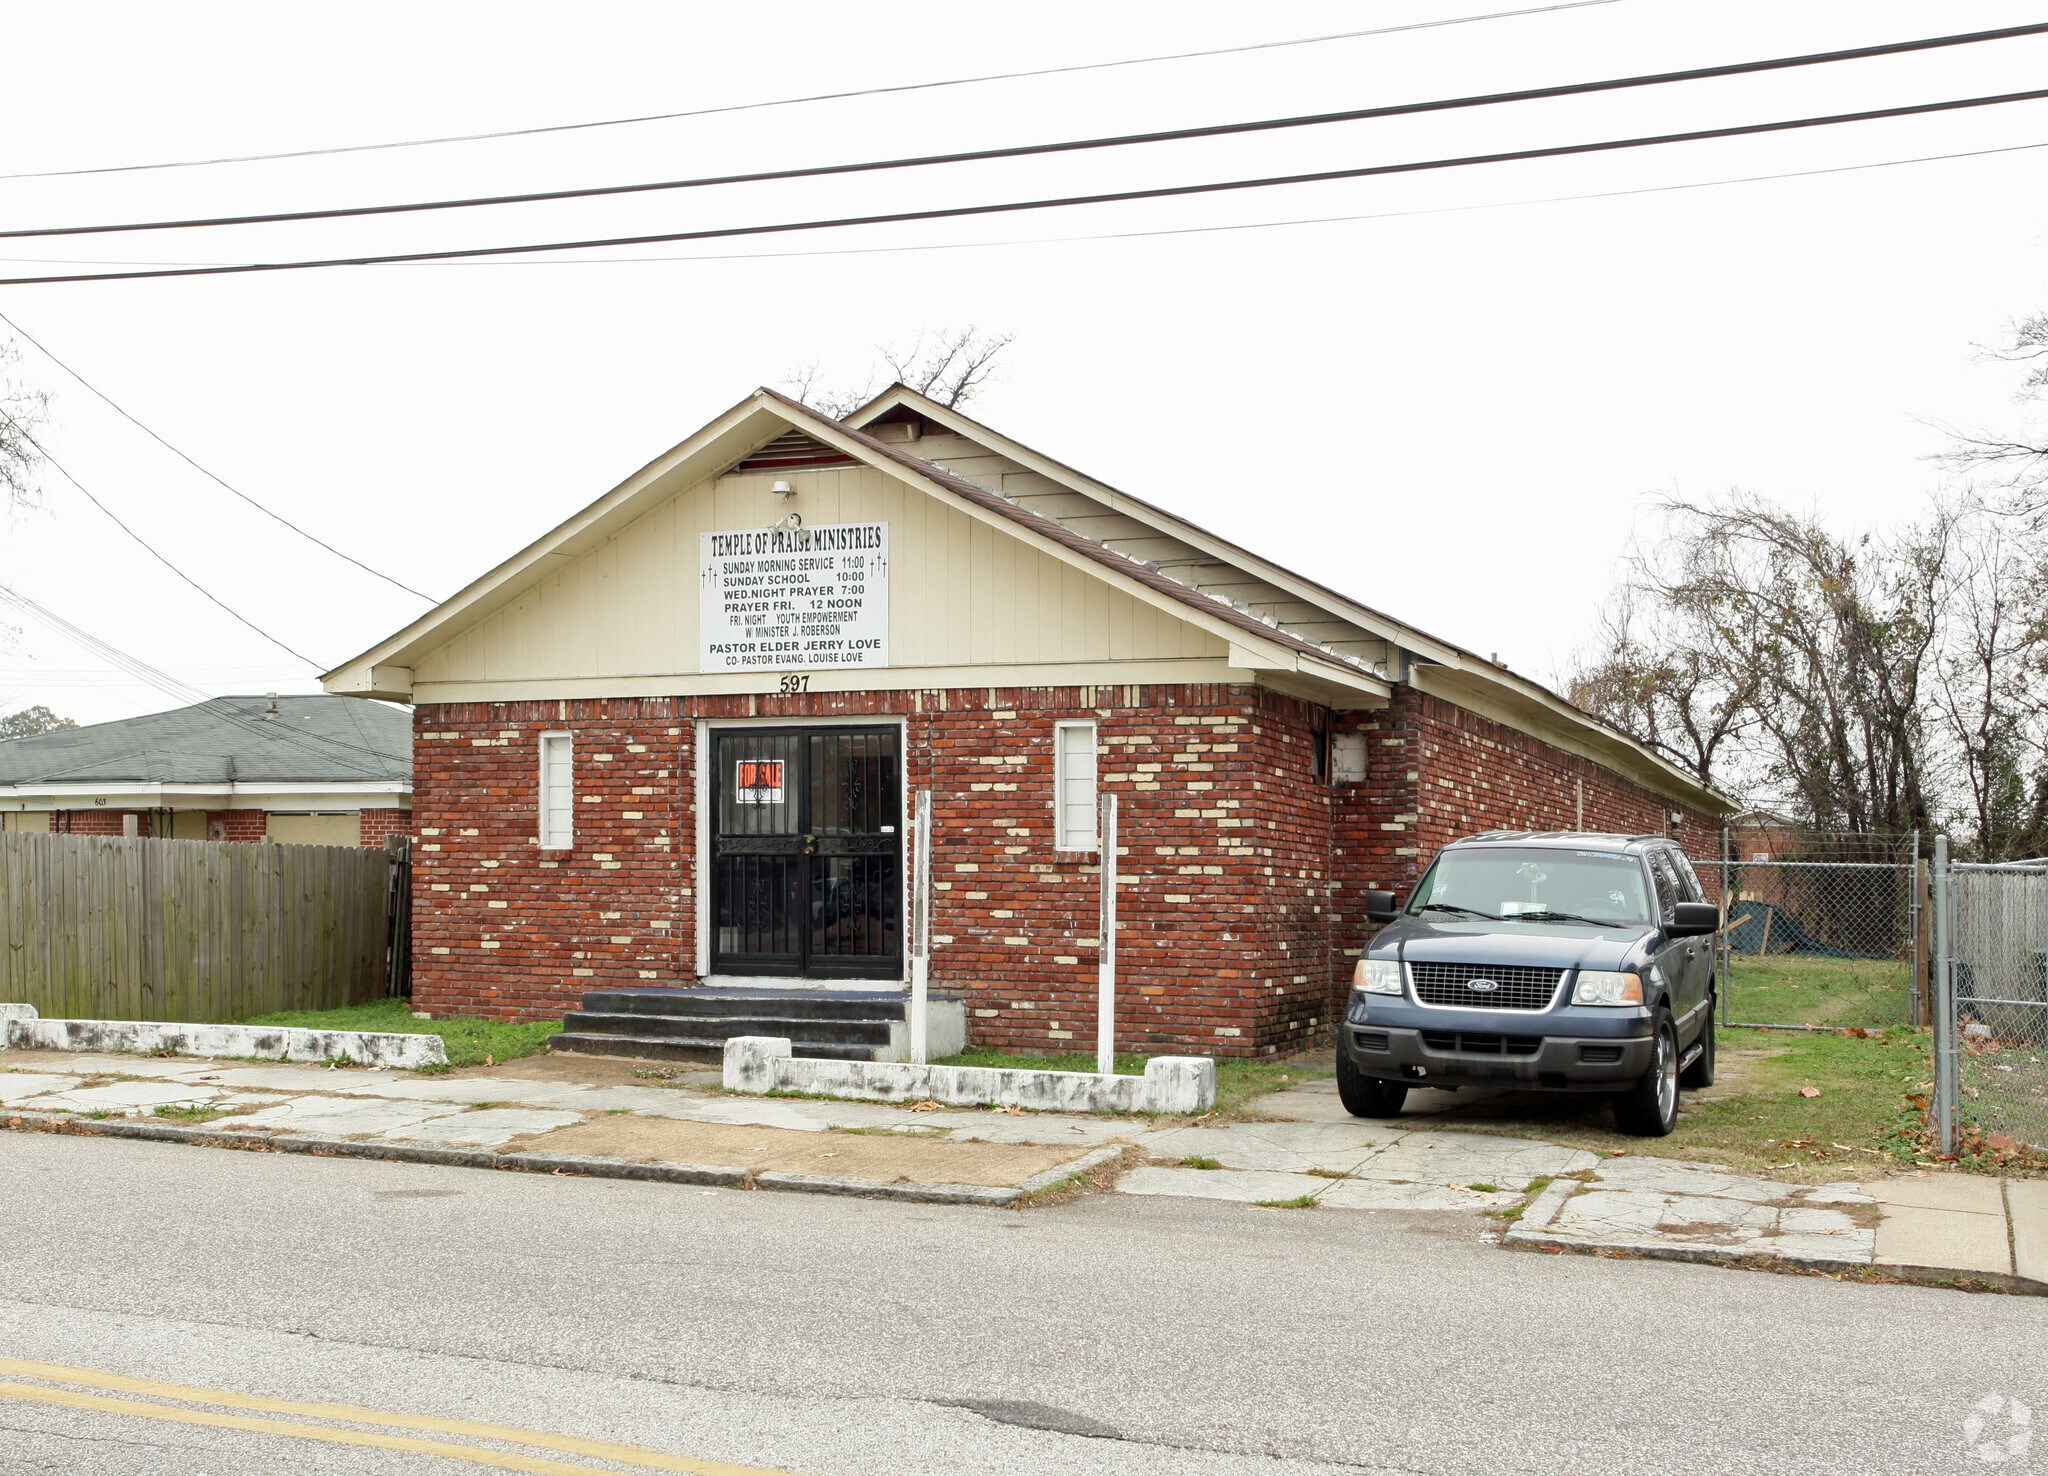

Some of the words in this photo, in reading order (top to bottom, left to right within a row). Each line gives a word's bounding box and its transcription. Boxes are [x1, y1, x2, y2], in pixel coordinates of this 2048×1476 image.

[712, 534, 752, 558] TEMPLE
[755, 532, 768, 554] OF
[814, 526, 881, 552] MINISTRIES
[723, 560, 754, 574] SUNDAY
[758, 558, 796, 573] MORNING
[798, 556, 834, 571] SERVICE
[842, 556, 864, 568] 11:00
[724, 576, 764, 588] SUNDAY
[768, 573, 810, 586] SCHOOL
[836, 572, 864, 582] 10:00
[724, 588, 786, 600] WED.NIGHT
[790, 586, 834, 596] PRAYER
[841, 584, 864, 595] 7:00
[724, 602, 769, 613] PRAYER
[773, 600, 794, 610] FRI.
[810, 600, 823, 609] 12
[827, 598, 862, 608] NOON
[730, 615, 742, 626] FRI.
[744, 614, 766, 626] NIGHT
[776, 612, 800, 624] YOUTH
[802, 611, 858, 624] EMPOWERMENT
[756, 626, 789, 638] MINISTER
[792, 626, 798, 636] J.
[800, 624, 840, 636] ROBERSON
[710, 642, 756, 654] PASTOR
[760, 641, 800, 652] ELDER
[804, 640, 844, 650] JERRY
[848, 639, 881, 650] LOVE
[726, 656, 740, 666] CO-
[742, 654, 773, 665] PASTOR
[776, 654, 806, 664] EVANG.
[808, 652, 838, 663] LOUISE
[842, 652, 863, 662] LOVE
[780, 674, 810, 694] 597
[740, 763, 757, 788] FOR
